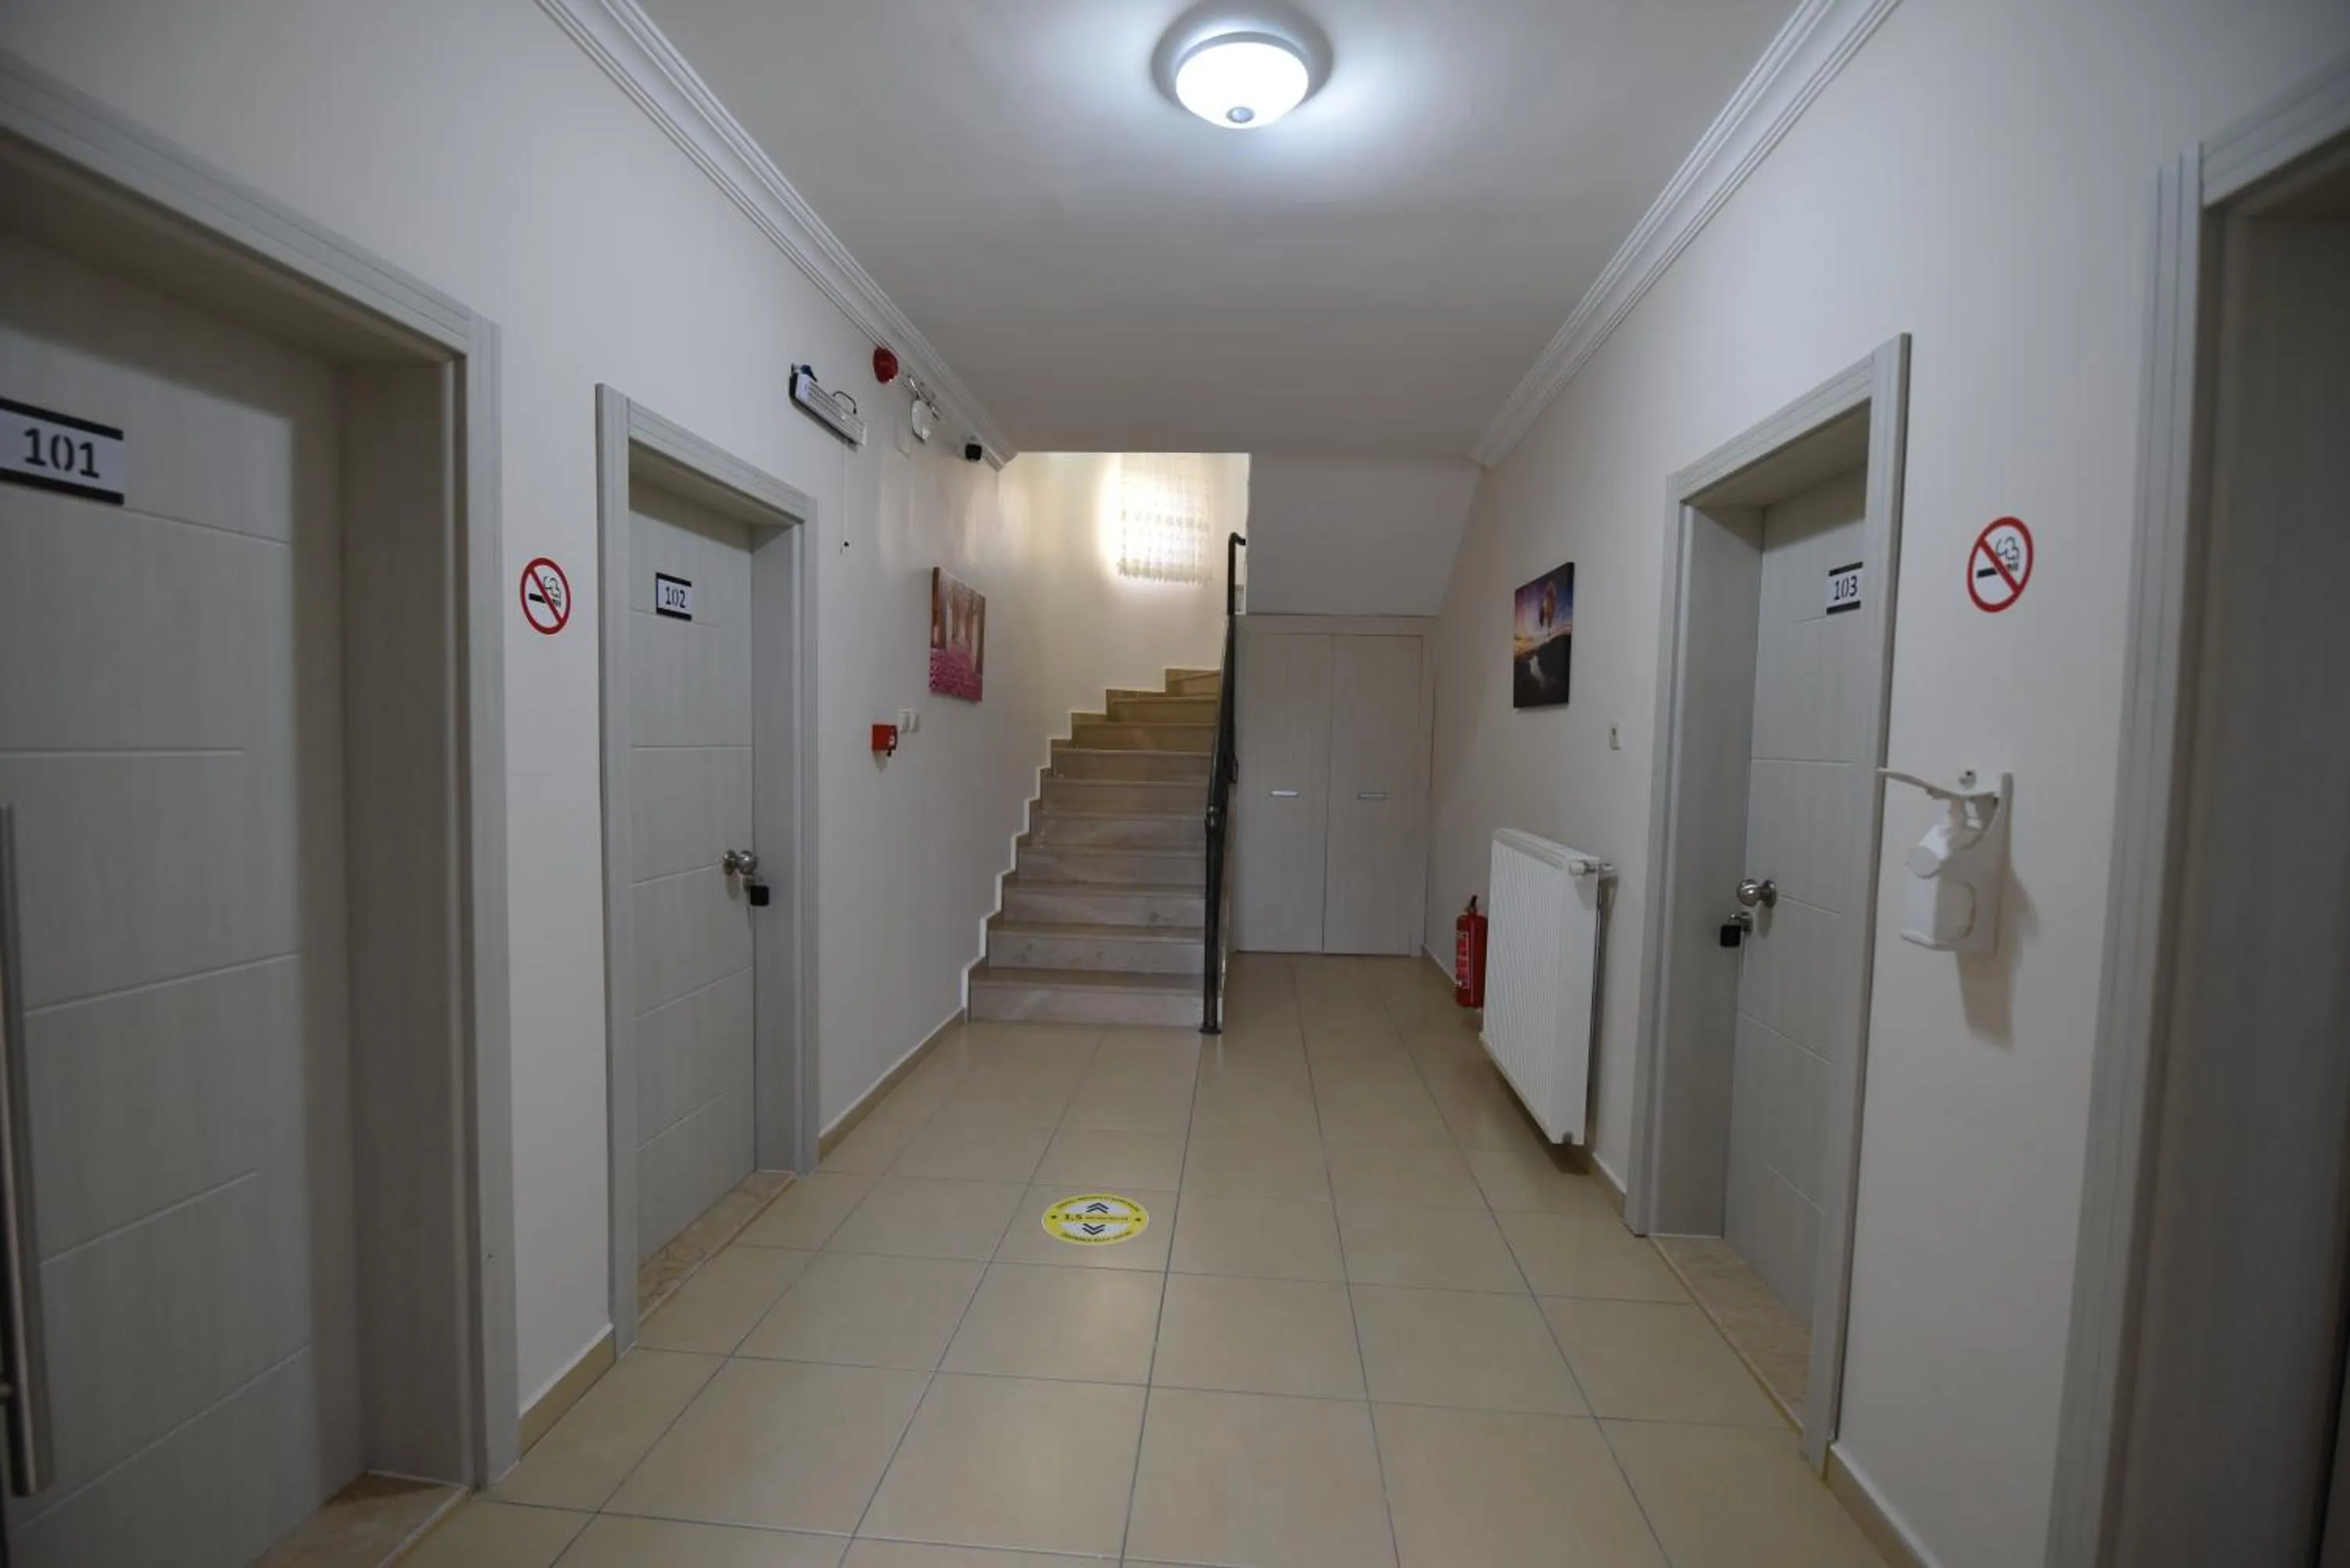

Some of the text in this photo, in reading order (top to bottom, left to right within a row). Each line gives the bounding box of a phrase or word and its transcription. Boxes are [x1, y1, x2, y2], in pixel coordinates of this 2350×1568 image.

[24, 428, 100, 479] 101
[666, 586, 685, 608] 102
[1834, 575, 1857, 600] 103
